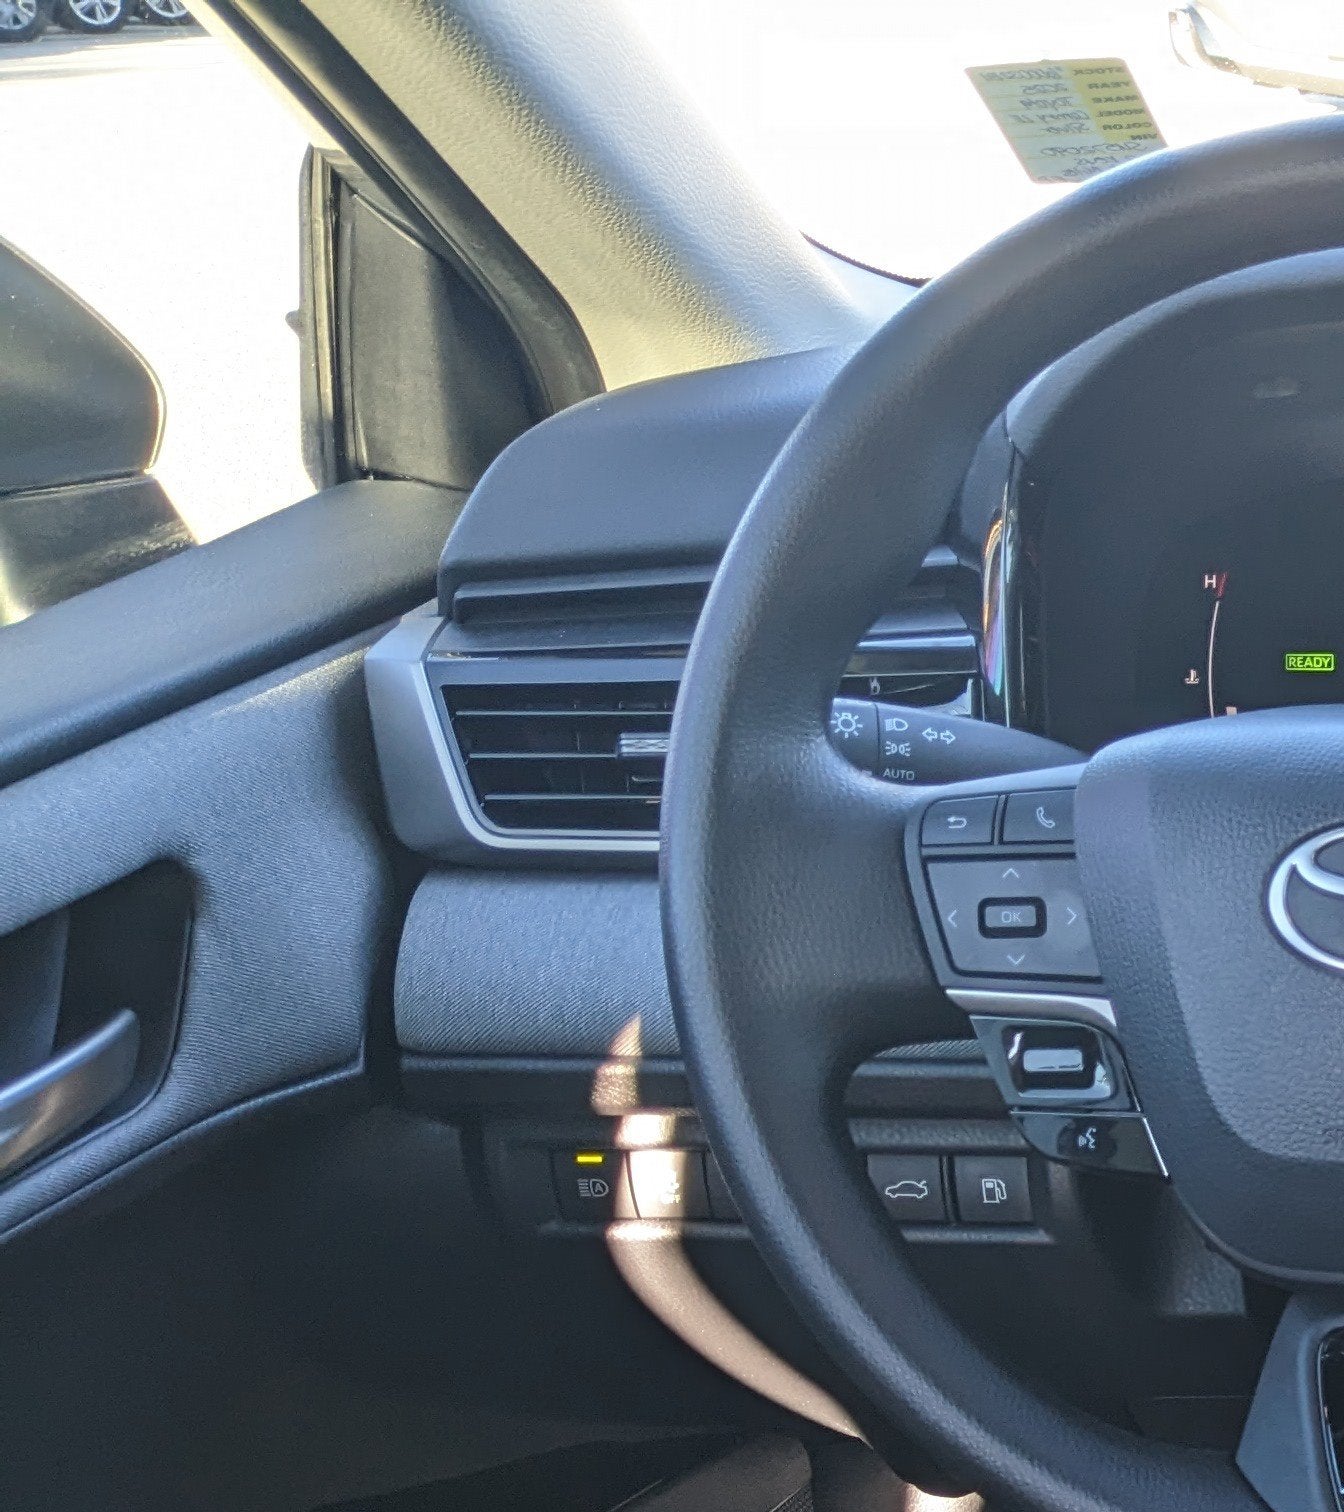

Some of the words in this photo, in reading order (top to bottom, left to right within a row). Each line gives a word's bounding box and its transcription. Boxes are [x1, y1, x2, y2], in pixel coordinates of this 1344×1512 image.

[1204, 574, 1217, 588] H
[1288, 657, 1333, 669] READY
[882, 768, 915, 781] AUTO
[1001, 910, 1022, 923] OK
